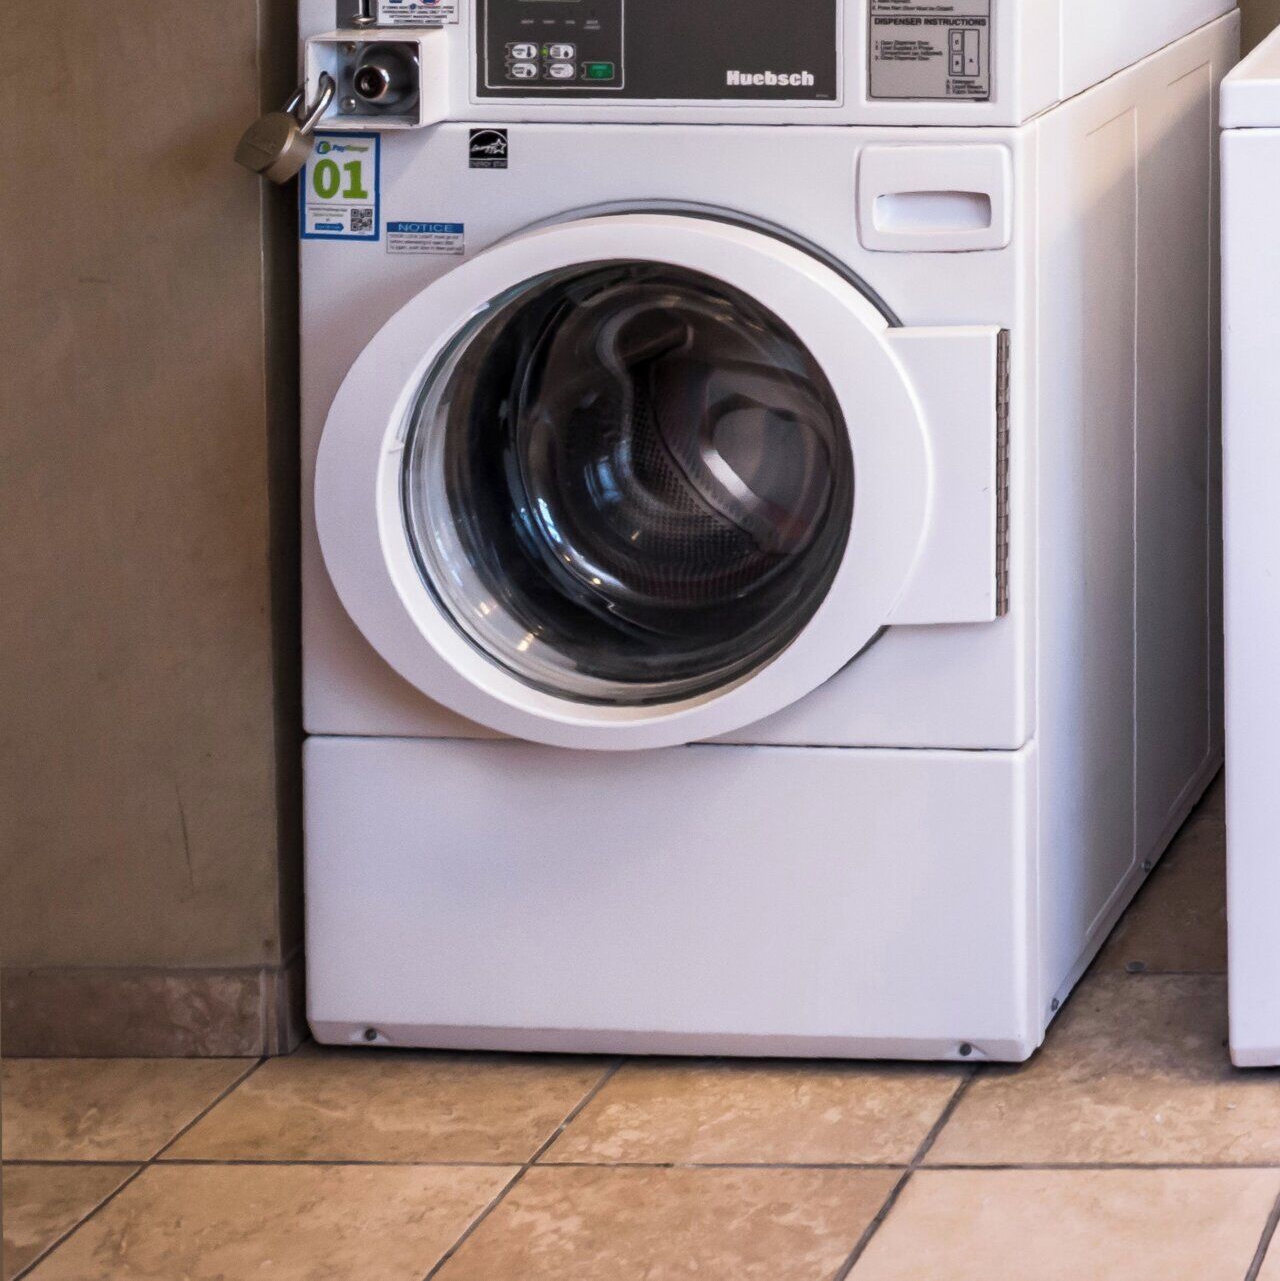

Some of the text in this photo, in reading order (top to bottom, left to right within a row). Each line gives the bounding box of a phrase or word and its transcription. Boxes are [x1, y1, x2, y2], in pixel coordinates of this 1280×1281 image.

[874, 18, 987, 27] DISPENSER INSTRUCTIONS
[726, 70, 815, 86] Huebsch
[312, 158, 369, 199] 01
[398, 223, 453, 232] NOTICE
